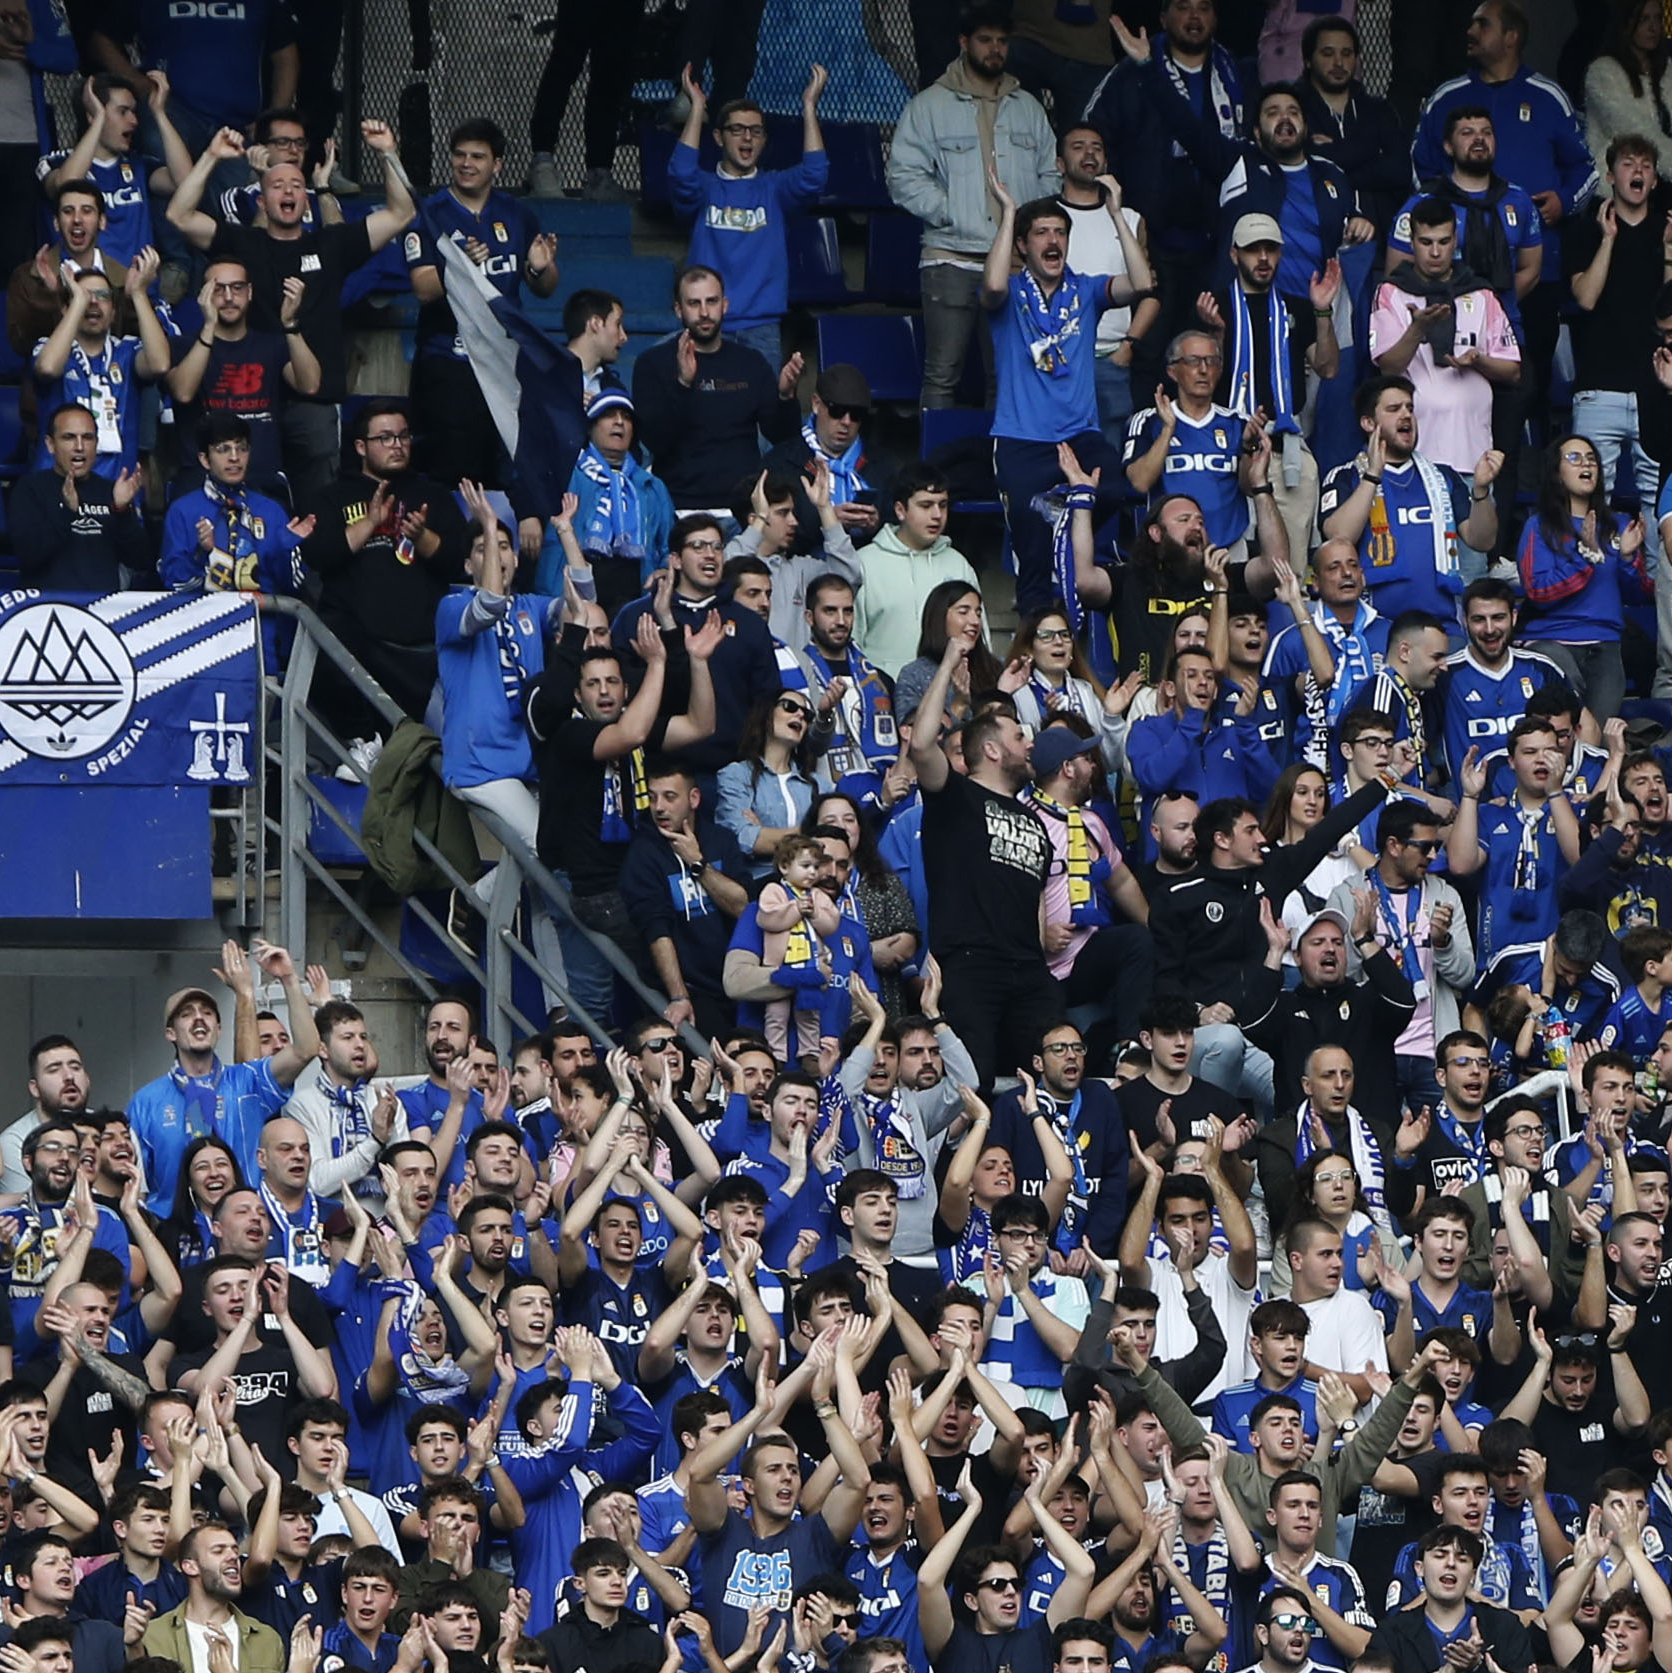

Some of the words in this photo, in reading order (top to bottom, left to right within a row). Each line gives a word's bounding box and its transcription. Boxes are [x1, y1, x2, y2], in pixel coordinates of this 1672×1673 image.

[168, 2, 245, 19] DIGI
[1165, 455, 1239, 476] DIGI
[86, 719, 150, 777] SPEZIAL
[727, 1549, 792, 1594] 1926
